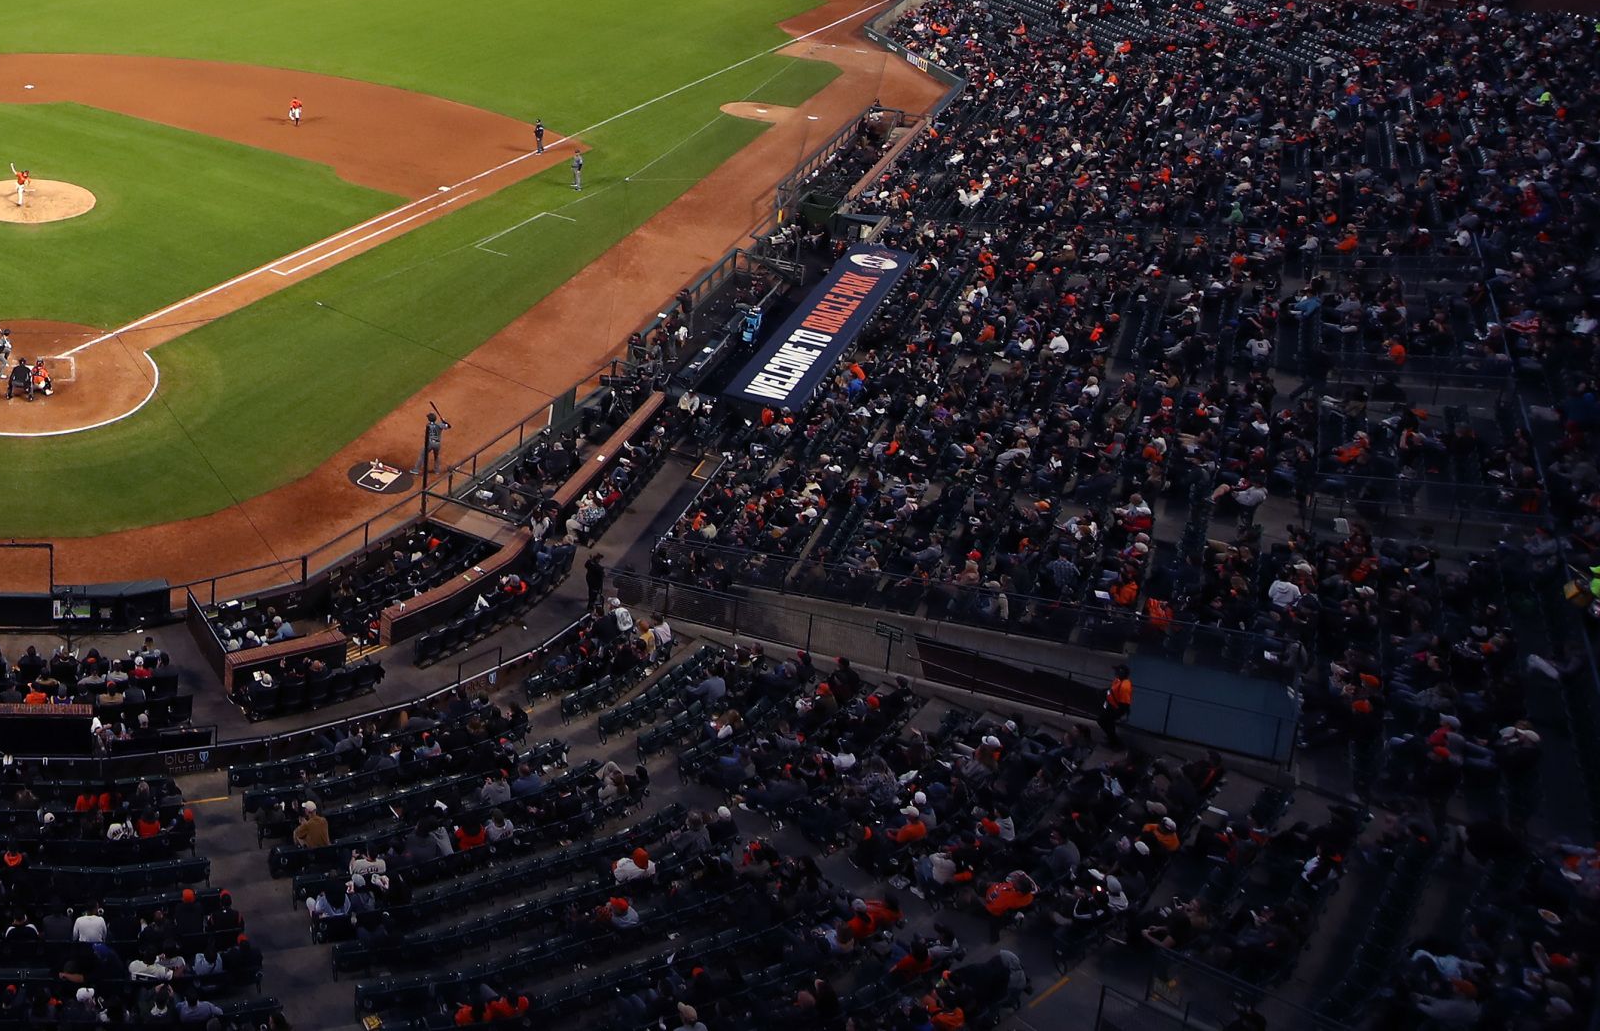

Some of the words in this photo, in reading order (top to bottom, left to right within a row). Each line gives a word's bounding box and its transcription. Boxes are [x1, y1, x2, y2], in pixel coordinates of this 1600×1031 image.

[830, 271, 880, 299] PARK
[800, 294, 861, 334] ORACLE
[788, 329, 833, 348] TO
[743, 342, 823, 400] WELCOME
